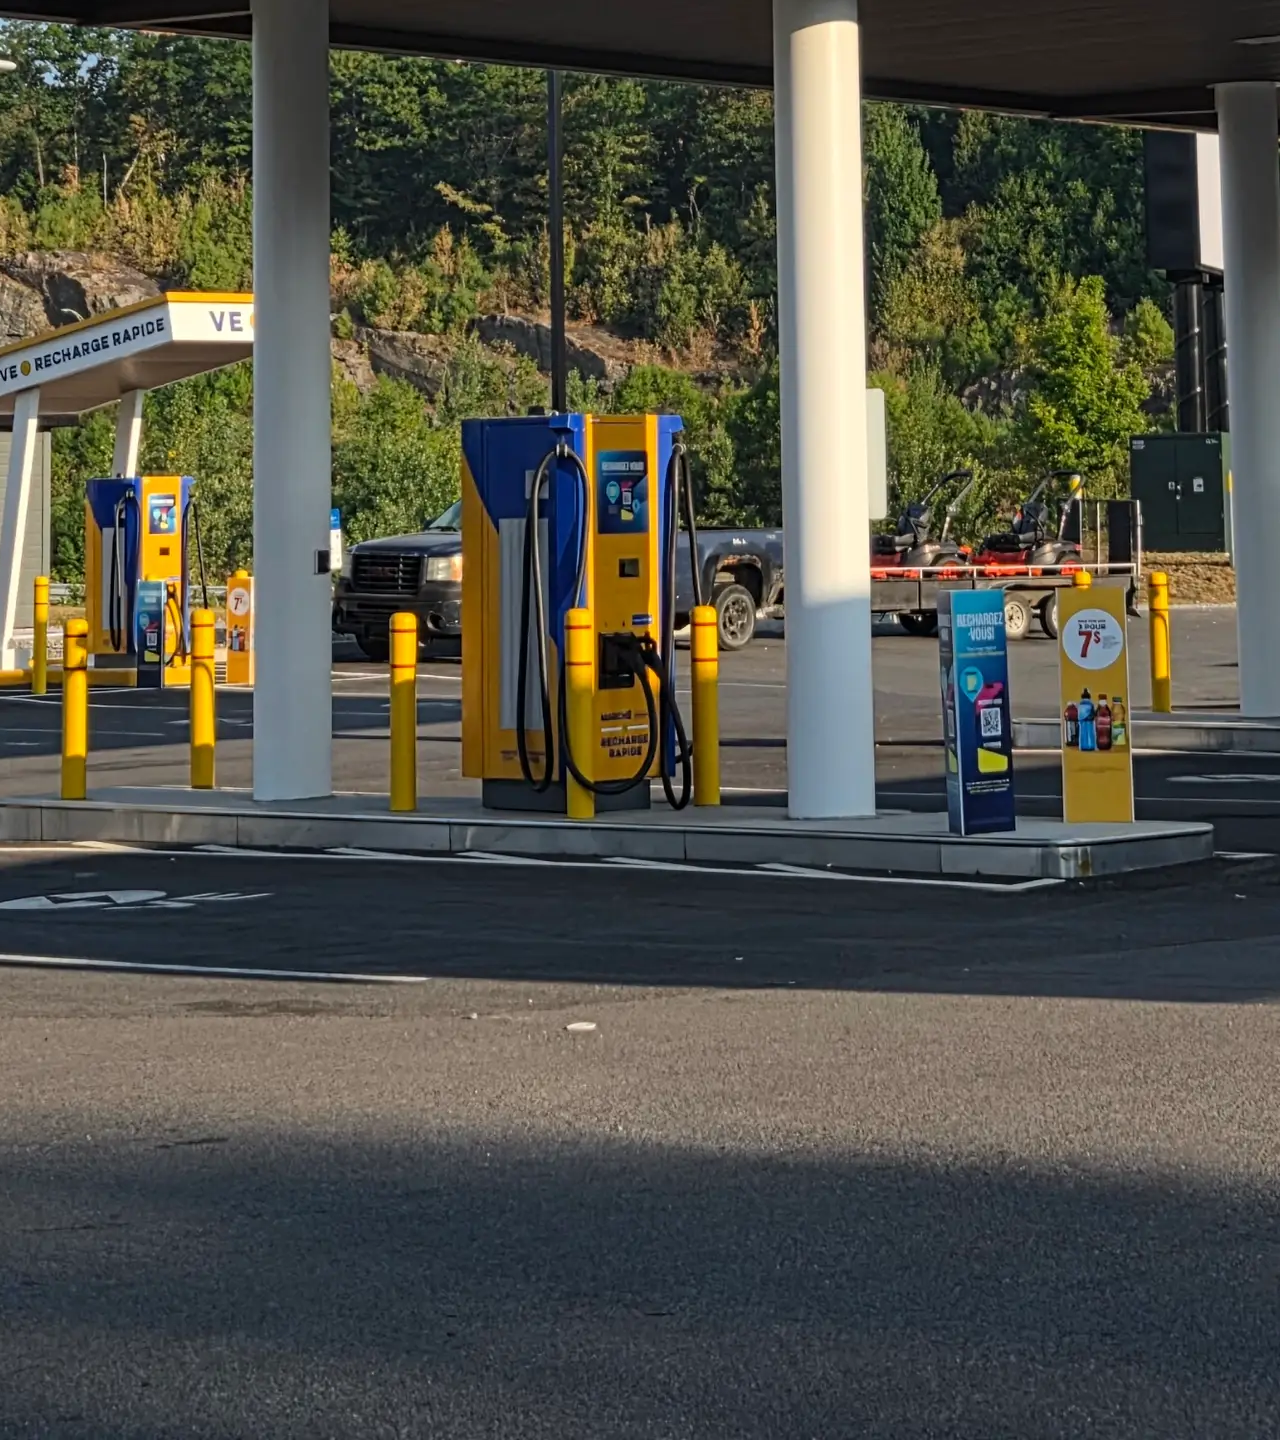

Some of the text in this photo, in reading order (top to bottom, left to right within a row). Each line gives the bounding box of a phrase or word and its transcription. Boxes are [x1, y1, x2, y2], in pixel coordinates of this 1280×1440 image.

[209, 311, 243, 332] VE
[0, 317, 165, 382] VE RECHARGE RAPIDE
[956, 612, 1003, 627] RECHARGEZ
